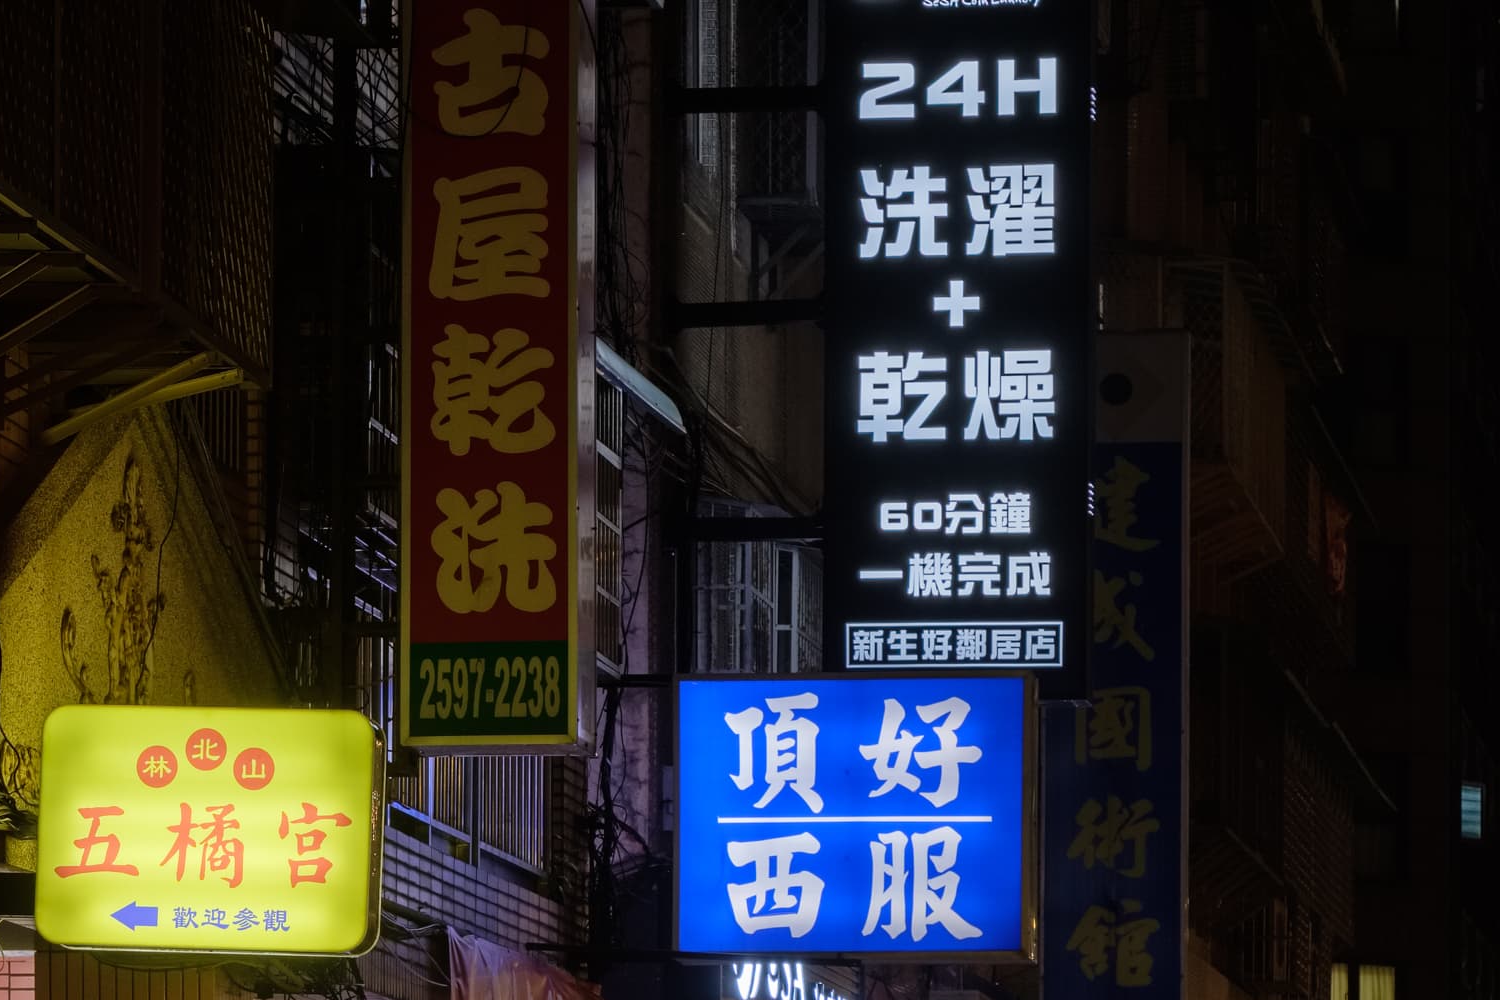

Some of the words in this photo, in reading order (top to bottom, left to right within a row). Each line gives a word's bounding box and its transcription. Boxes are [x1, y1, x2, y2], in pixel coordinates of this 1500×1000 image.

[859, 57, 1057, 118] 24H
[859, 163, 1055, 258] 洗濯
[857, 350, 1055, 442] 乾燥
[880, 493, 1031, 534] 60分鐘
[859, 552, 1051, 597] 一機完成
[852, 629, 1057, 661] 新生好鄰居店
[419, 655, 561, 720] 2597-2238
[54, 802, 353, 889] 五橘宮
[172, 907, 291, 932] 歡迎參觀
